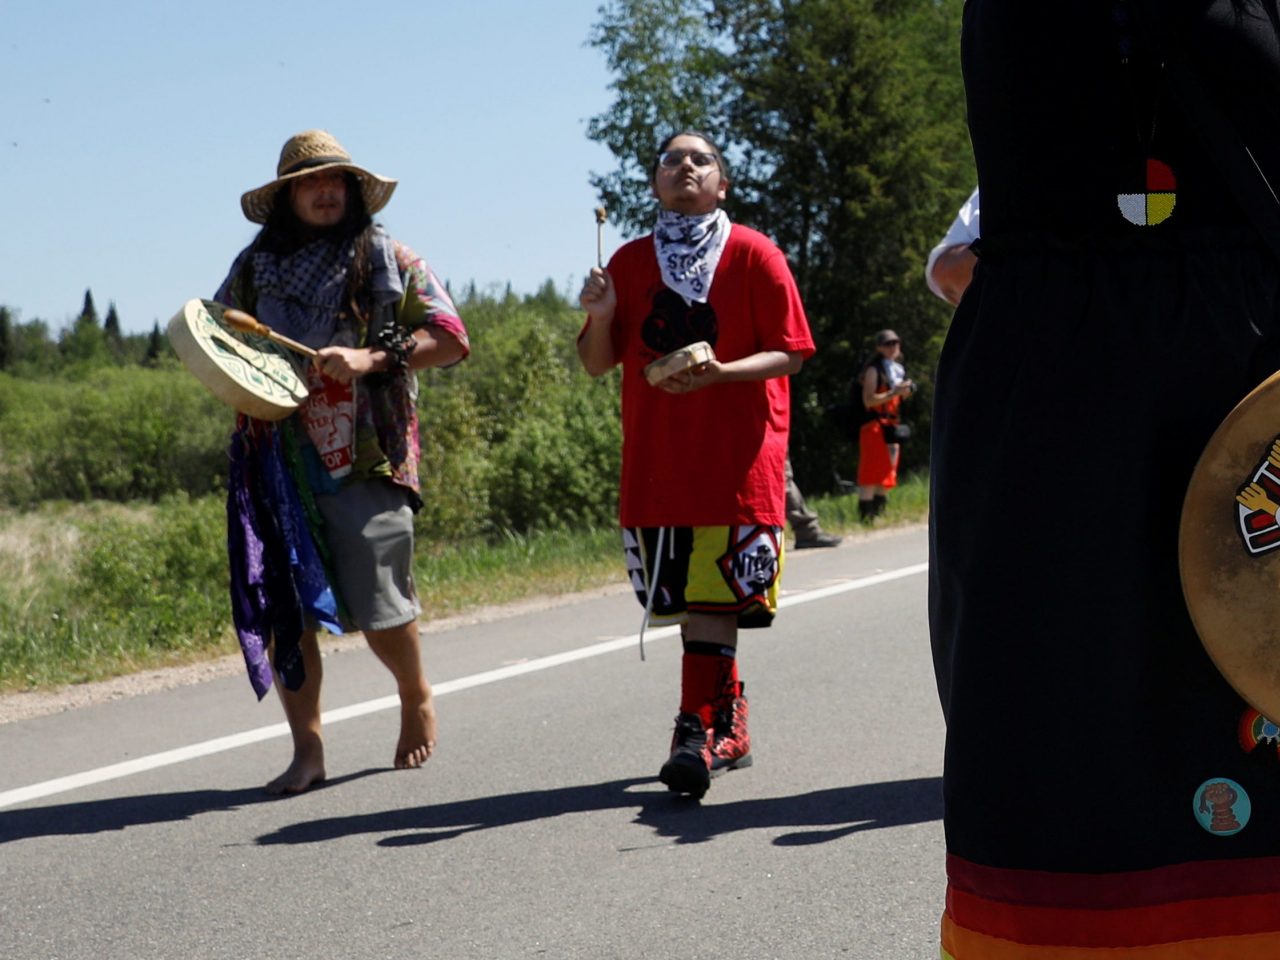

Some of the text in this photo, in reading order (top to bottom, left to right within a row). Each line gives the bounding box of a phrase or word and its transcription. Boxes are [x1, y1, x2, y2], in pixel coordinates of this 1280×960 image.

[667, 246, 708, 270] STOP
[669, 262, 710, 282] LINE
[690, 278, 704, 293] 3
